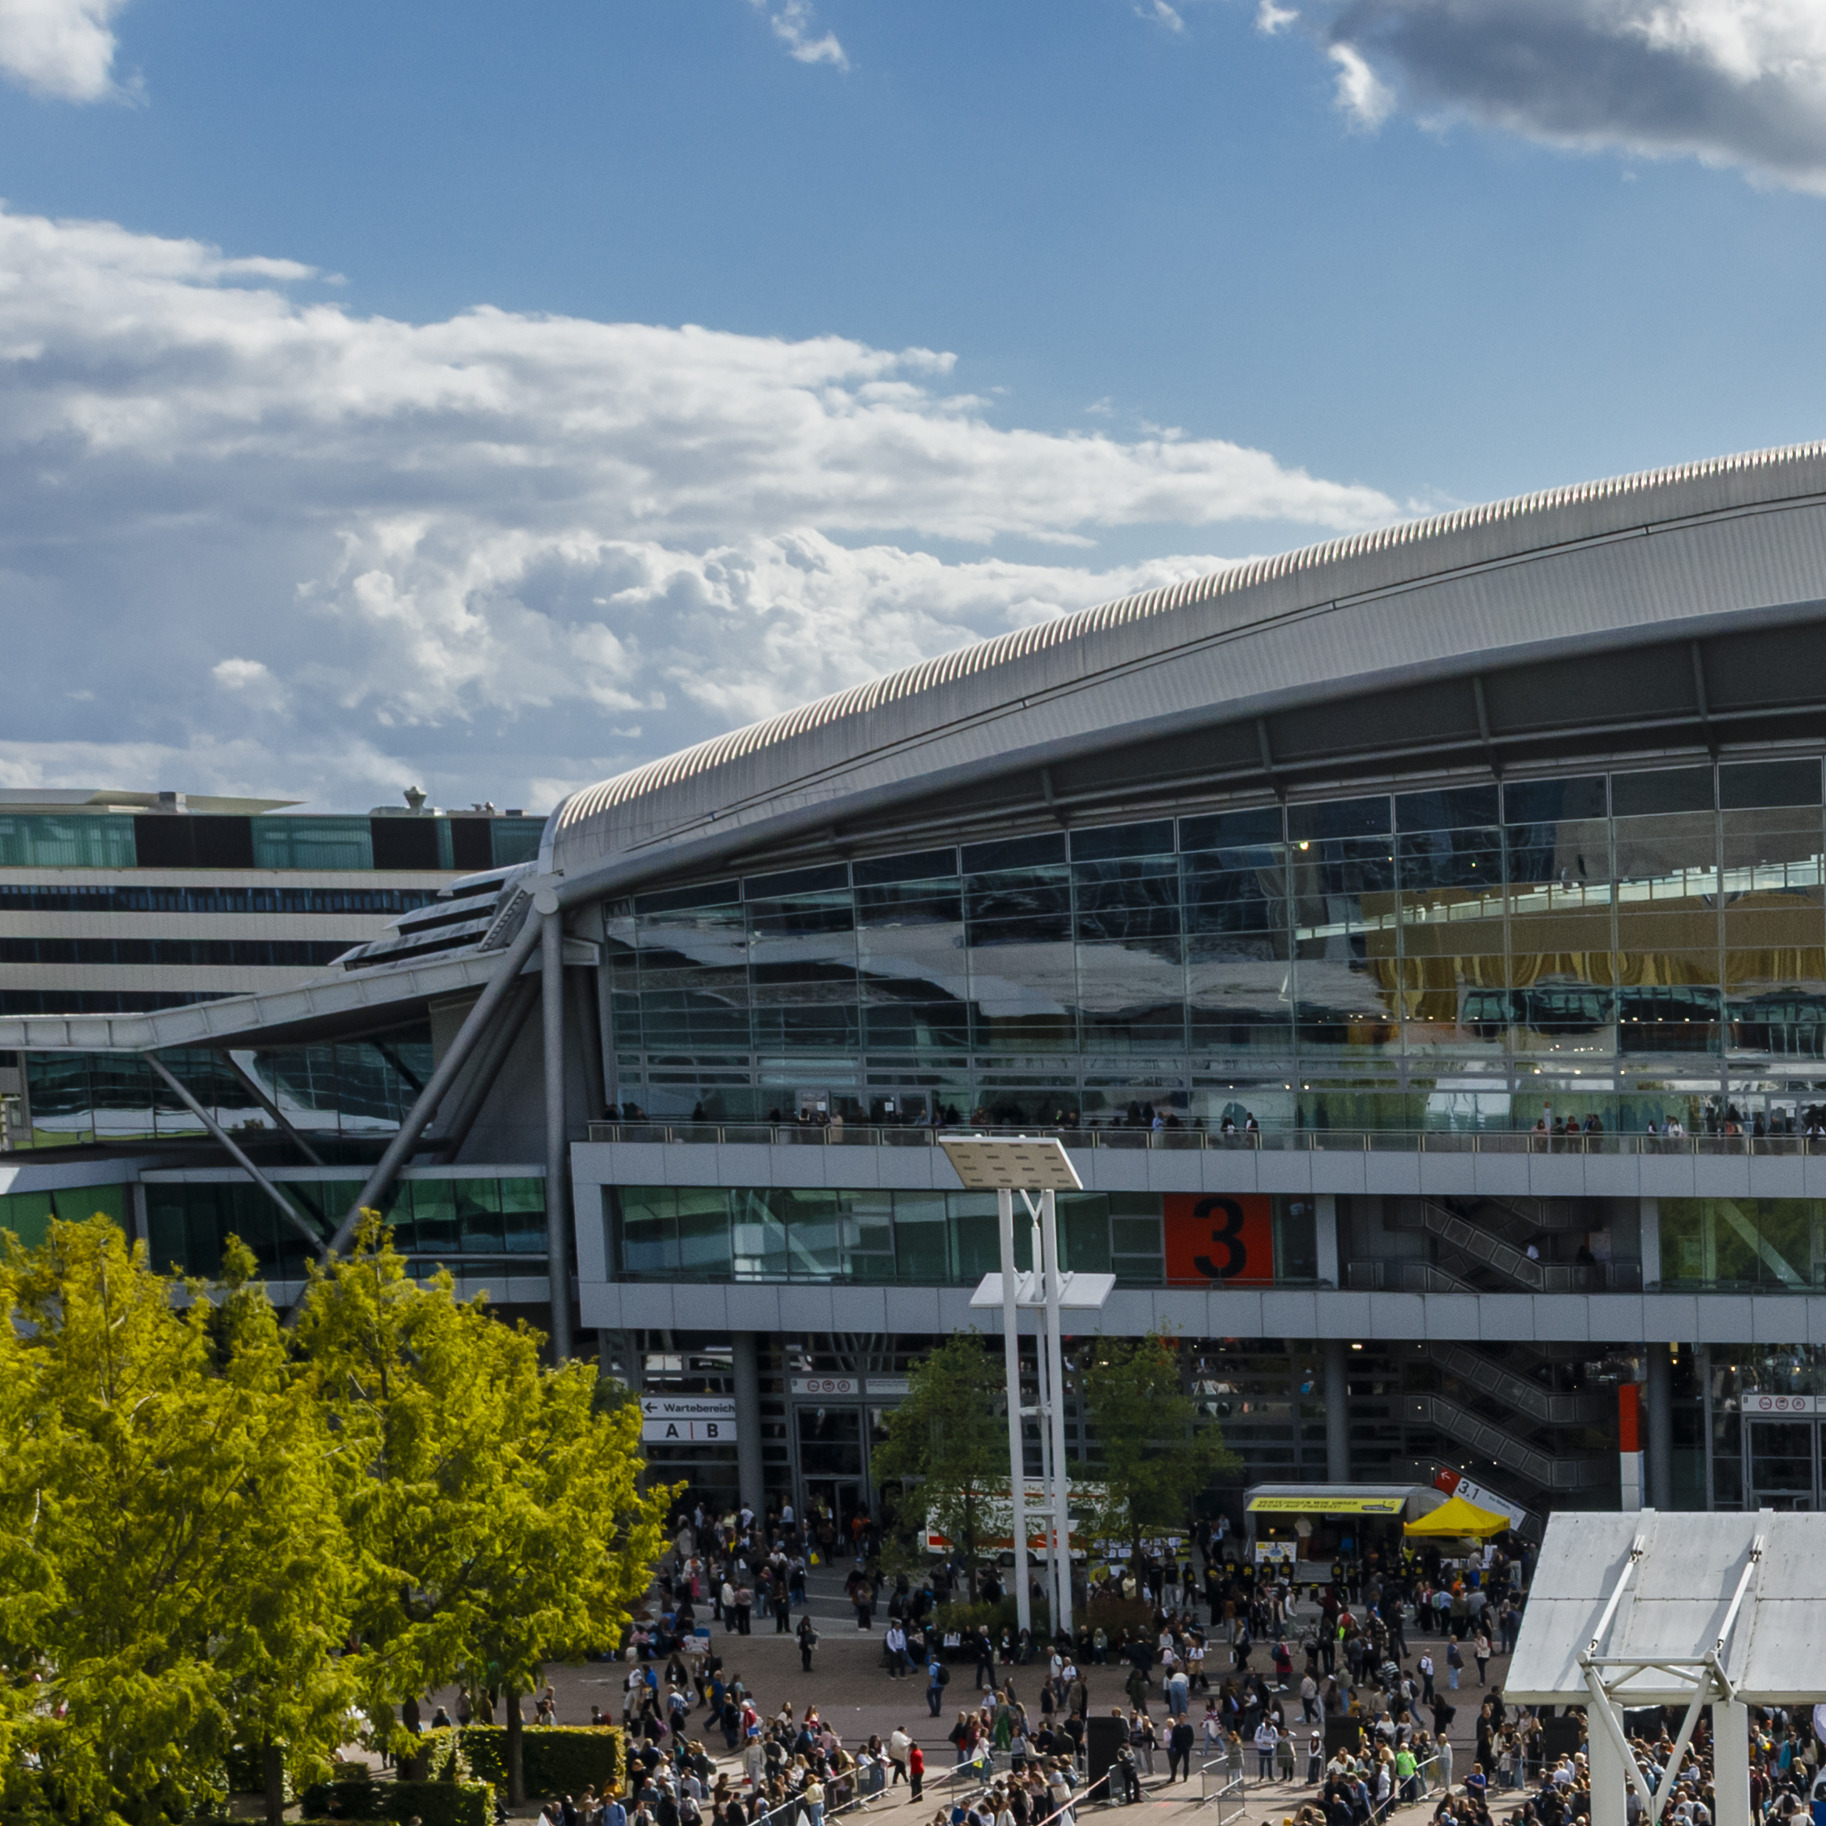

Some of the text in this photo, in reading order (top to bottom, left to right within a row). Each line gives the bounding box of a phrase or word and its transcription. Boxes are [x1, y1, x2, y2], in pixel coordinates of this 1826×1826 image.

[1193, 1197, 1247, 1279] 3
[664, 1403, 735, 1413] Wartebereich
[665, 1423, 719, 1438] A B
[1457, 1480, 1480, 1501] 3.1
